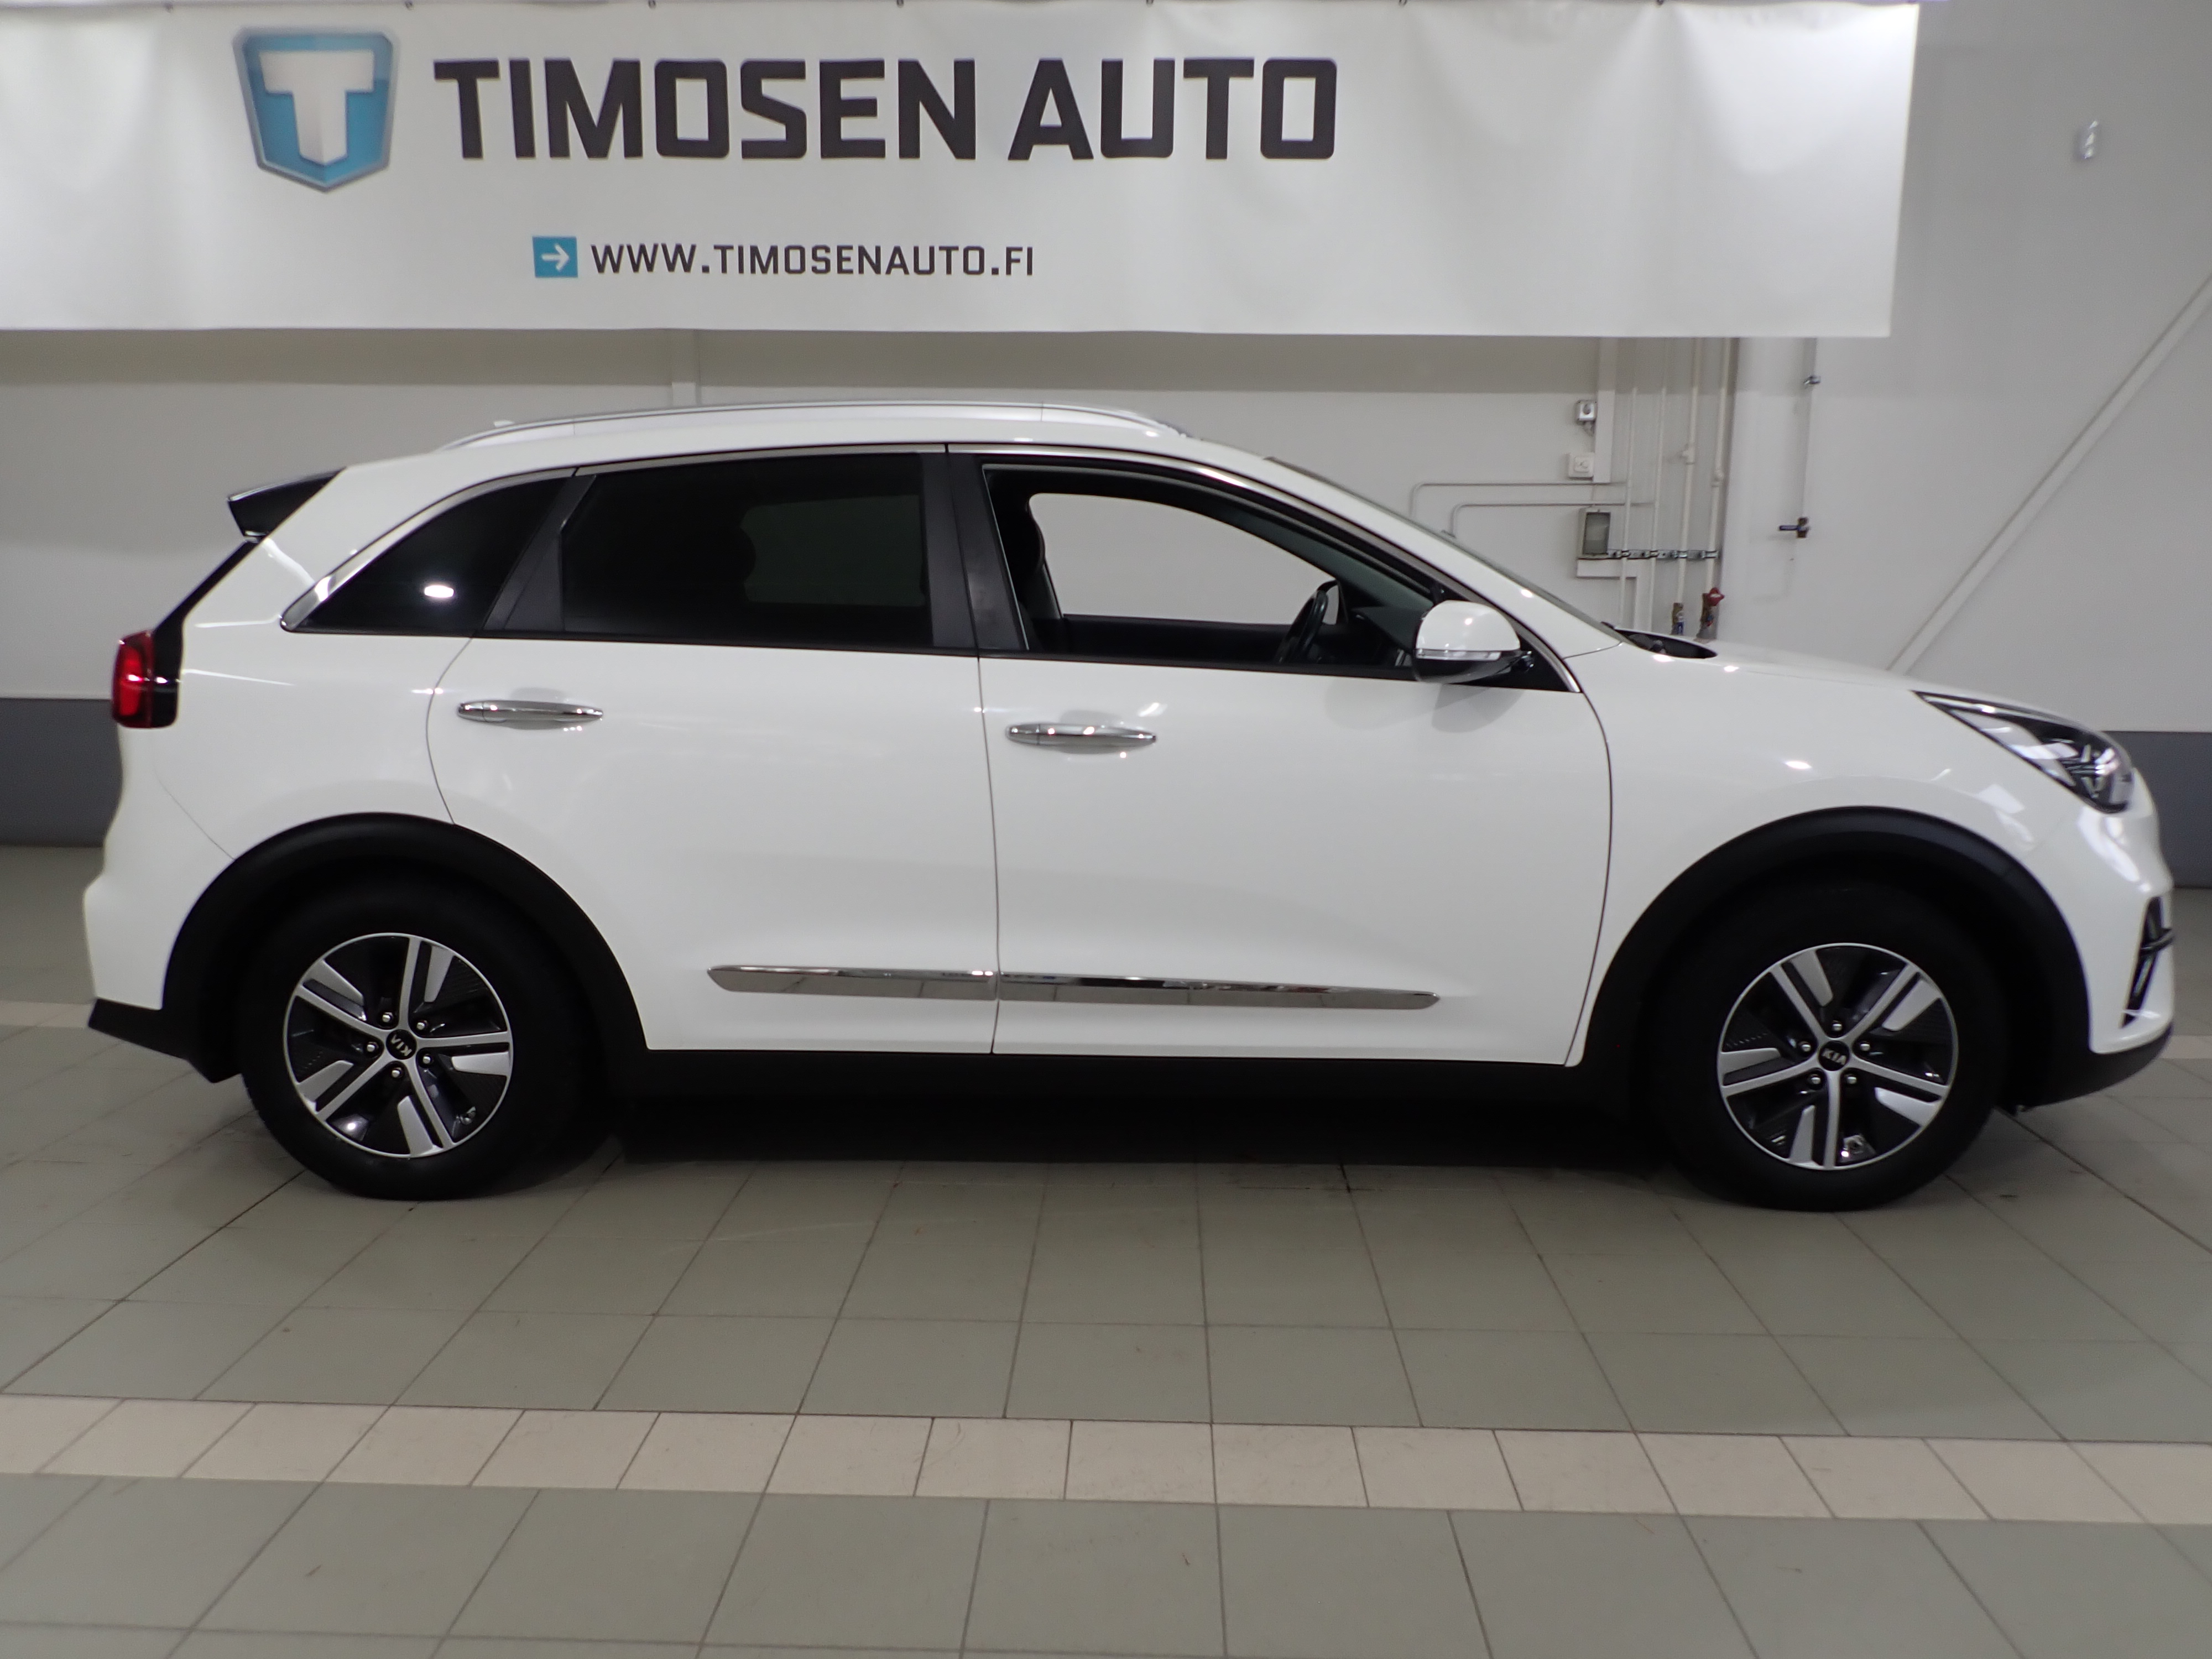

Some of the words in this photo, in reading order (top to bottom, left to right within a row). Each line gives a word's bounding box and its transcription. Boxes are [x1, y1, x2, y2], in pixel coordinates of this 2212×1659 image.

[434, 58, 975, 159] TIMOSEN
[1008, 58, 1337, 160] AUTO
[591, 244, 1034, 275] WWW.TIMOSENAUTO.FI
[390, 1035, 412, 1056] KIA
[1822, 1048, 1846, 1065] KIA
